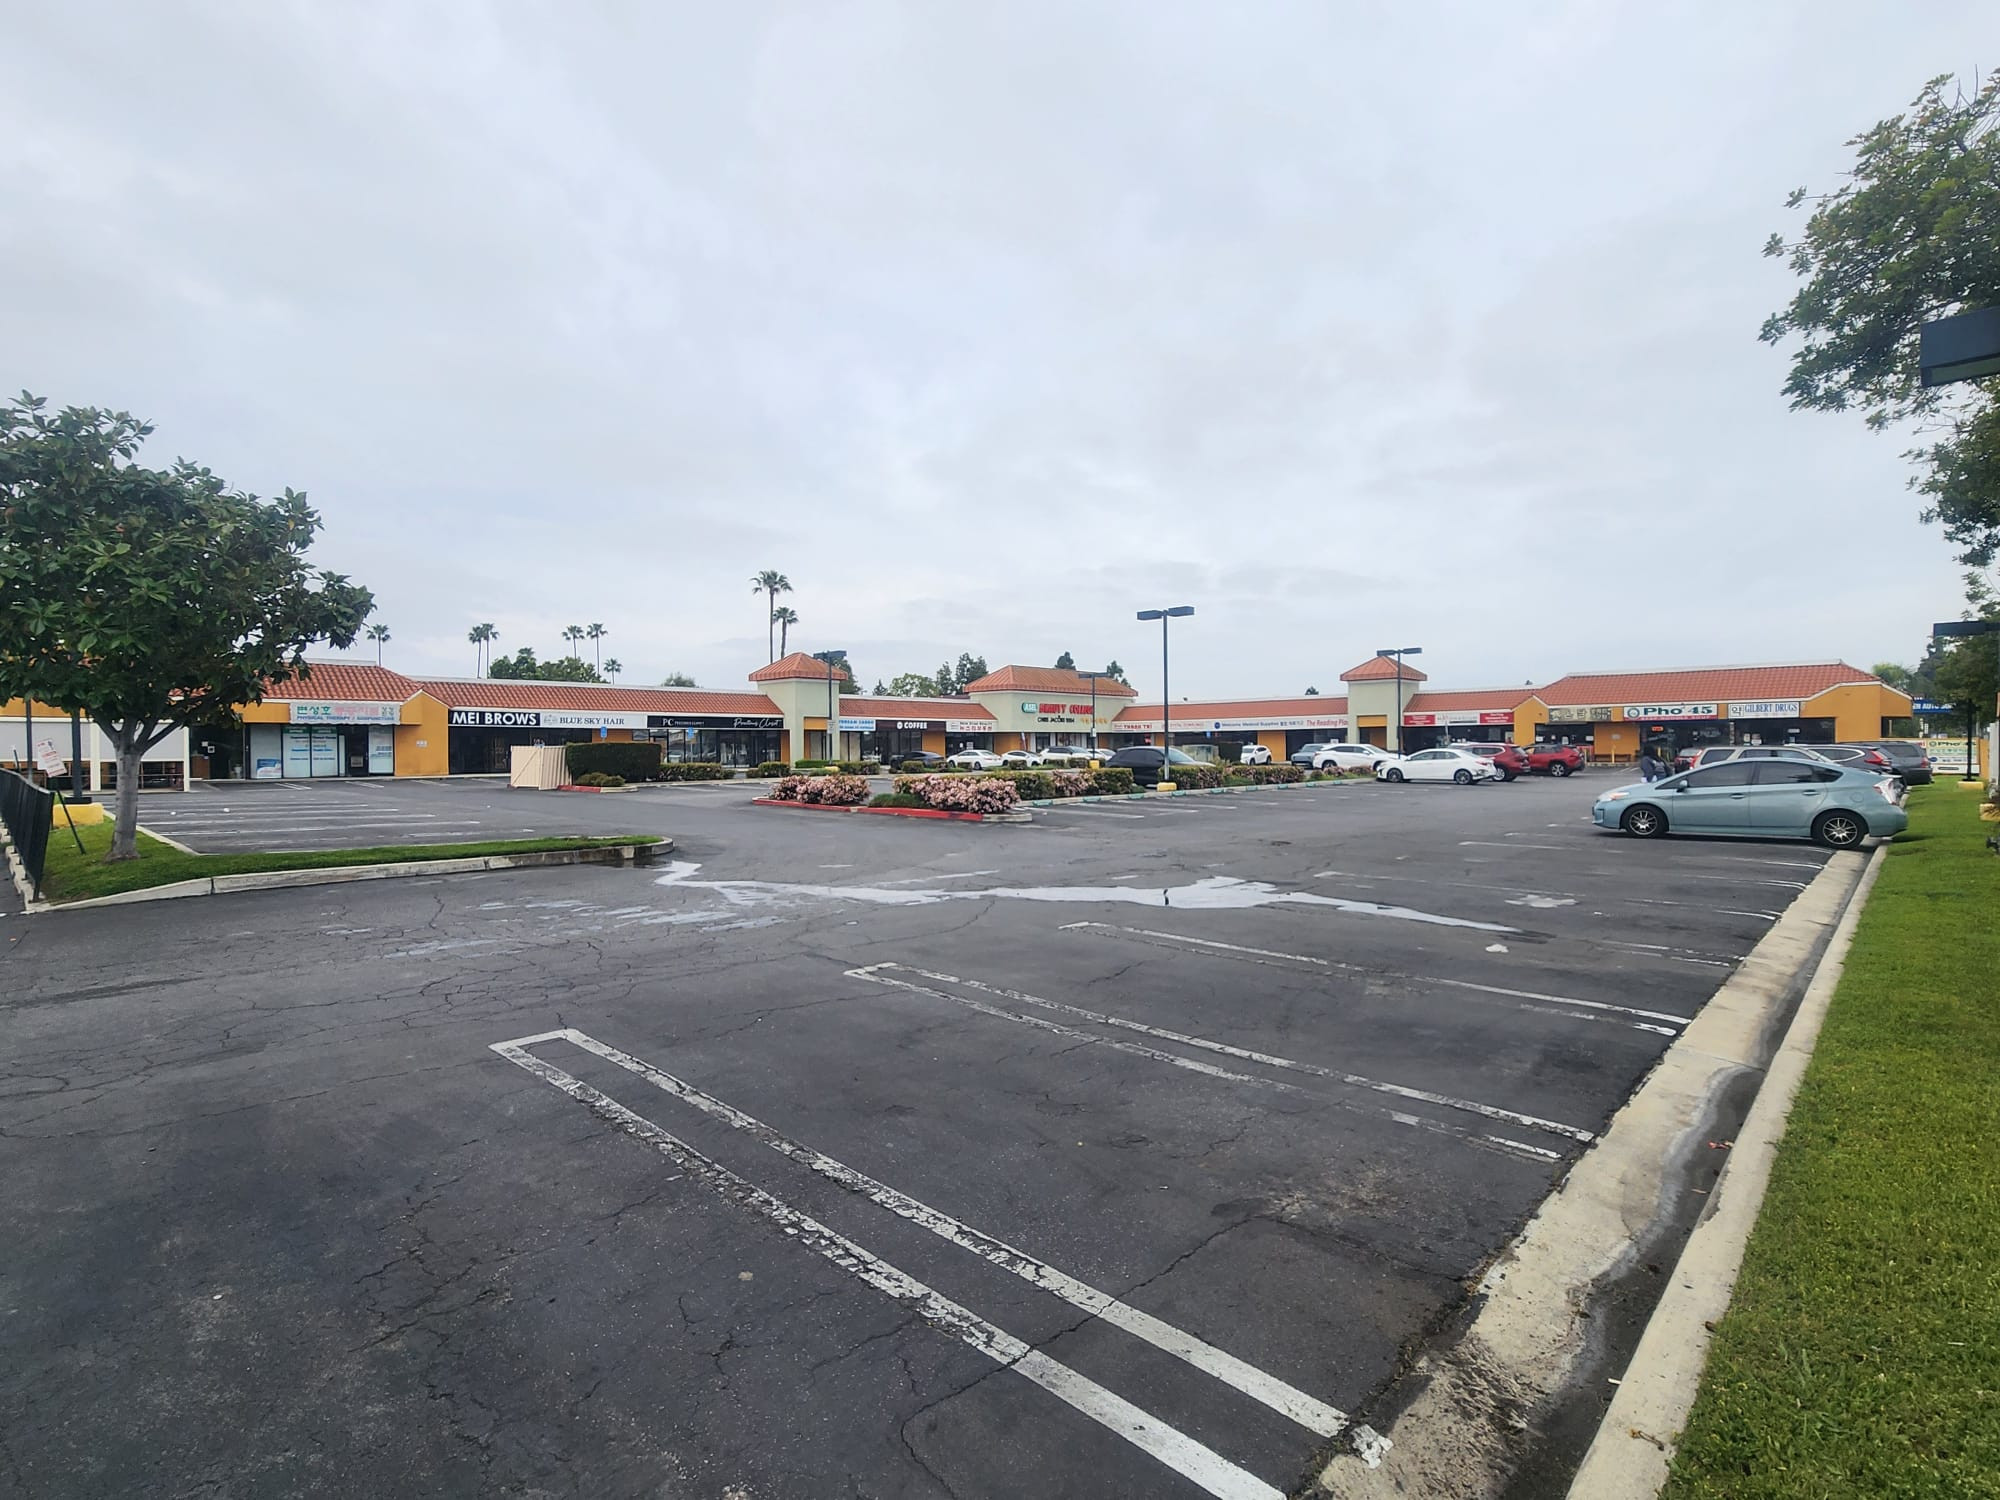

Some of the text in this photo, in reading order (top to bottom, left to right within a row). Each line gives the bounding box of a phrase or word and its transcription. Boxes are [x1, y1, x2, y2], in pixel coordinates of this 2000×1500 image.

[1687, 705, 1713, 714] 45
[1744, 702, 1798, 713] GILBERT DRUGS
[452, 712, 537, 726] MEI BROWS
[584, 717, 601, 725] SKY
[603, 717, 625, 725] HAIR
[662, 718, 674, 727] PC
[903, 721, 928, 729] COFFEE
